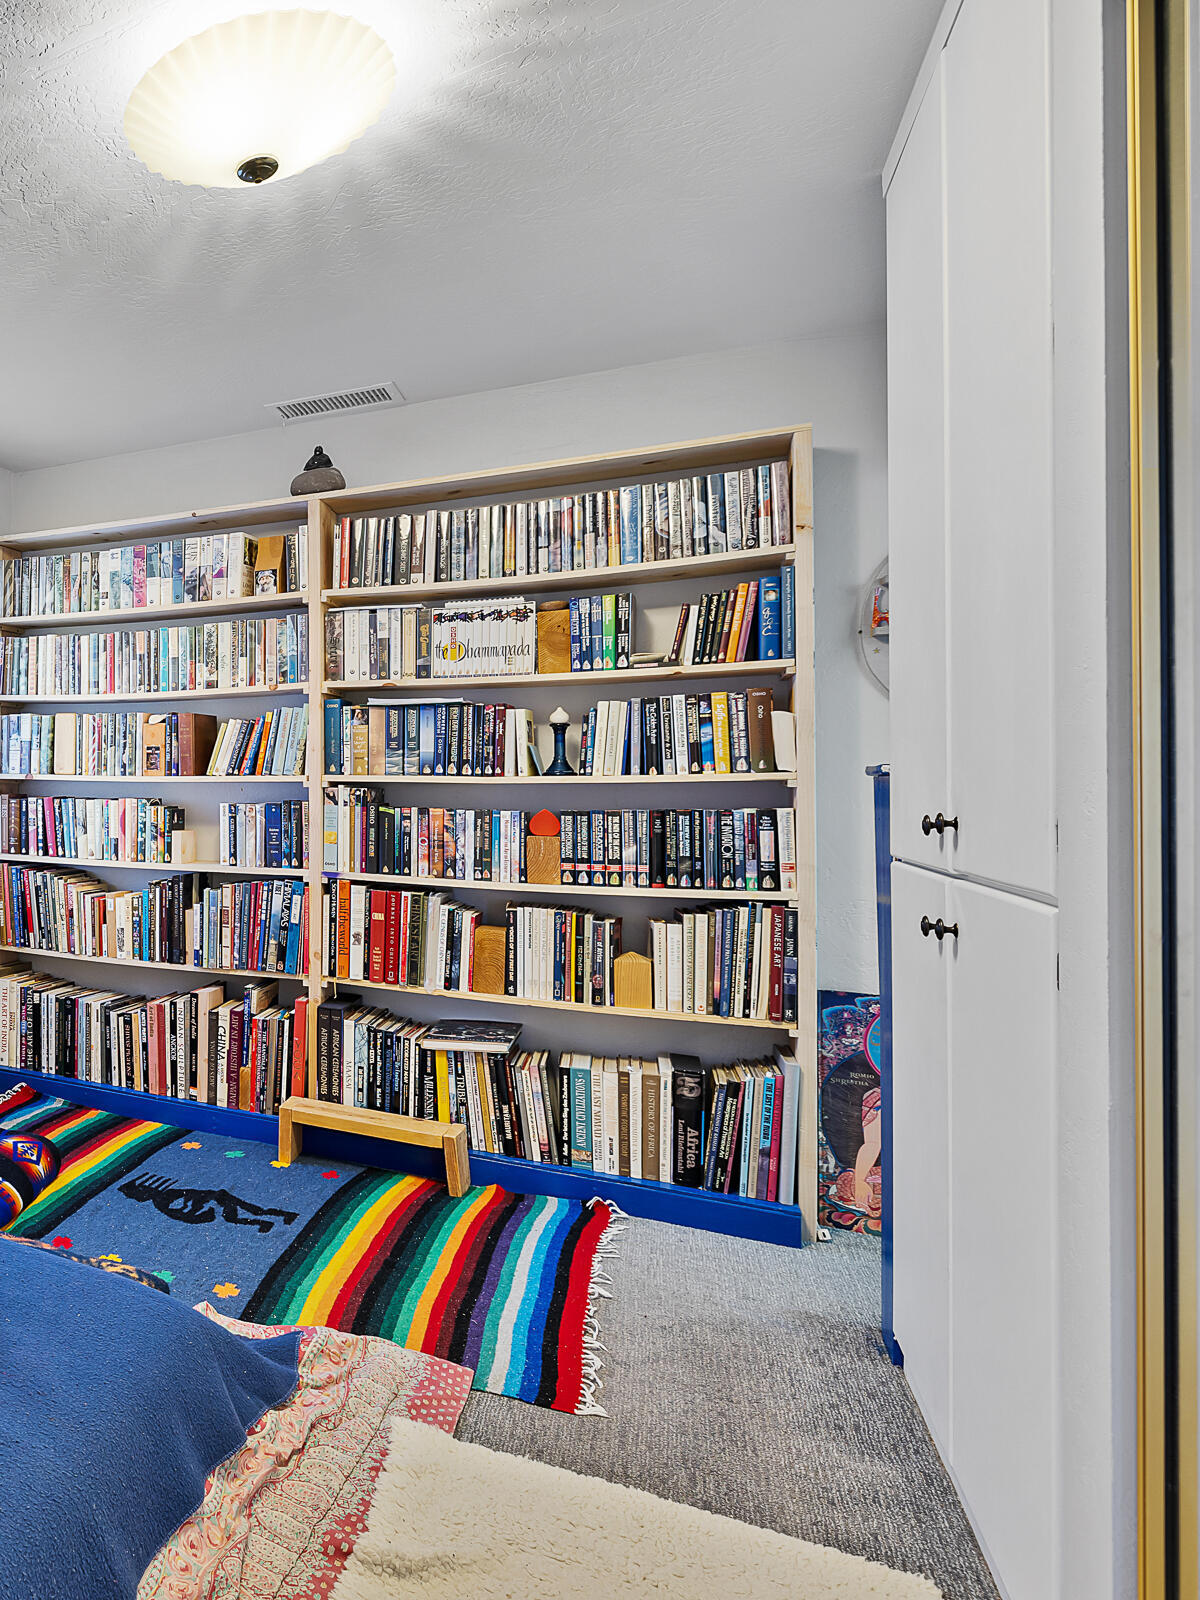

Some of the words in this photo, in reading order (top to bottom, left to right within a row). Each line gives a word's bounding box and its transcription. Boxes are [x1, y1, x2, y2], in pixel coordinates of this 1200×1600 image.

[455, 637, 530, 664] Dhammapada
[721, 816, 733, 826] THE
[722, 826, 734, 858] INVITATION
[280, 882, 291, 927] HIMALAYAS
[338, 898, 348, 913] half
[338, 914, 347, 930] the
[410, 896, 420, 940] CHINESE
[338, 930, 347, 956] world
[440, 938, 445, 946] OF
[774, 914, 782, 950] JAPANESE
[410, 943, 420, 962] ART
[2, 1020, 8, 1030] OF
[27, 1016, 33, 1028] OF
[232, 1030, 238, 1039] IN
[218, 1026, 226, 1060] CHINA
[456, 1076, 466, 1103] TRIBE
[593, 1074, 601, 1088] THE
[830, 1077, 869, 1087] SHRESTHA
[575, 1078, 585, 1120] CIVILIZATIONS
[593, 1089, 601, 1108] LAST
[723, 1097, 733, 1125] Masterpieces
[502, 1104, 512, 1140] MAURITANIE
[576, 1122, 586, 1147] ANCIENT
[593, 1110, 601, 1138] NOMAD
[648, 1122, 654, 1133] OF
[686, 1128, 698, 1168] Africa
